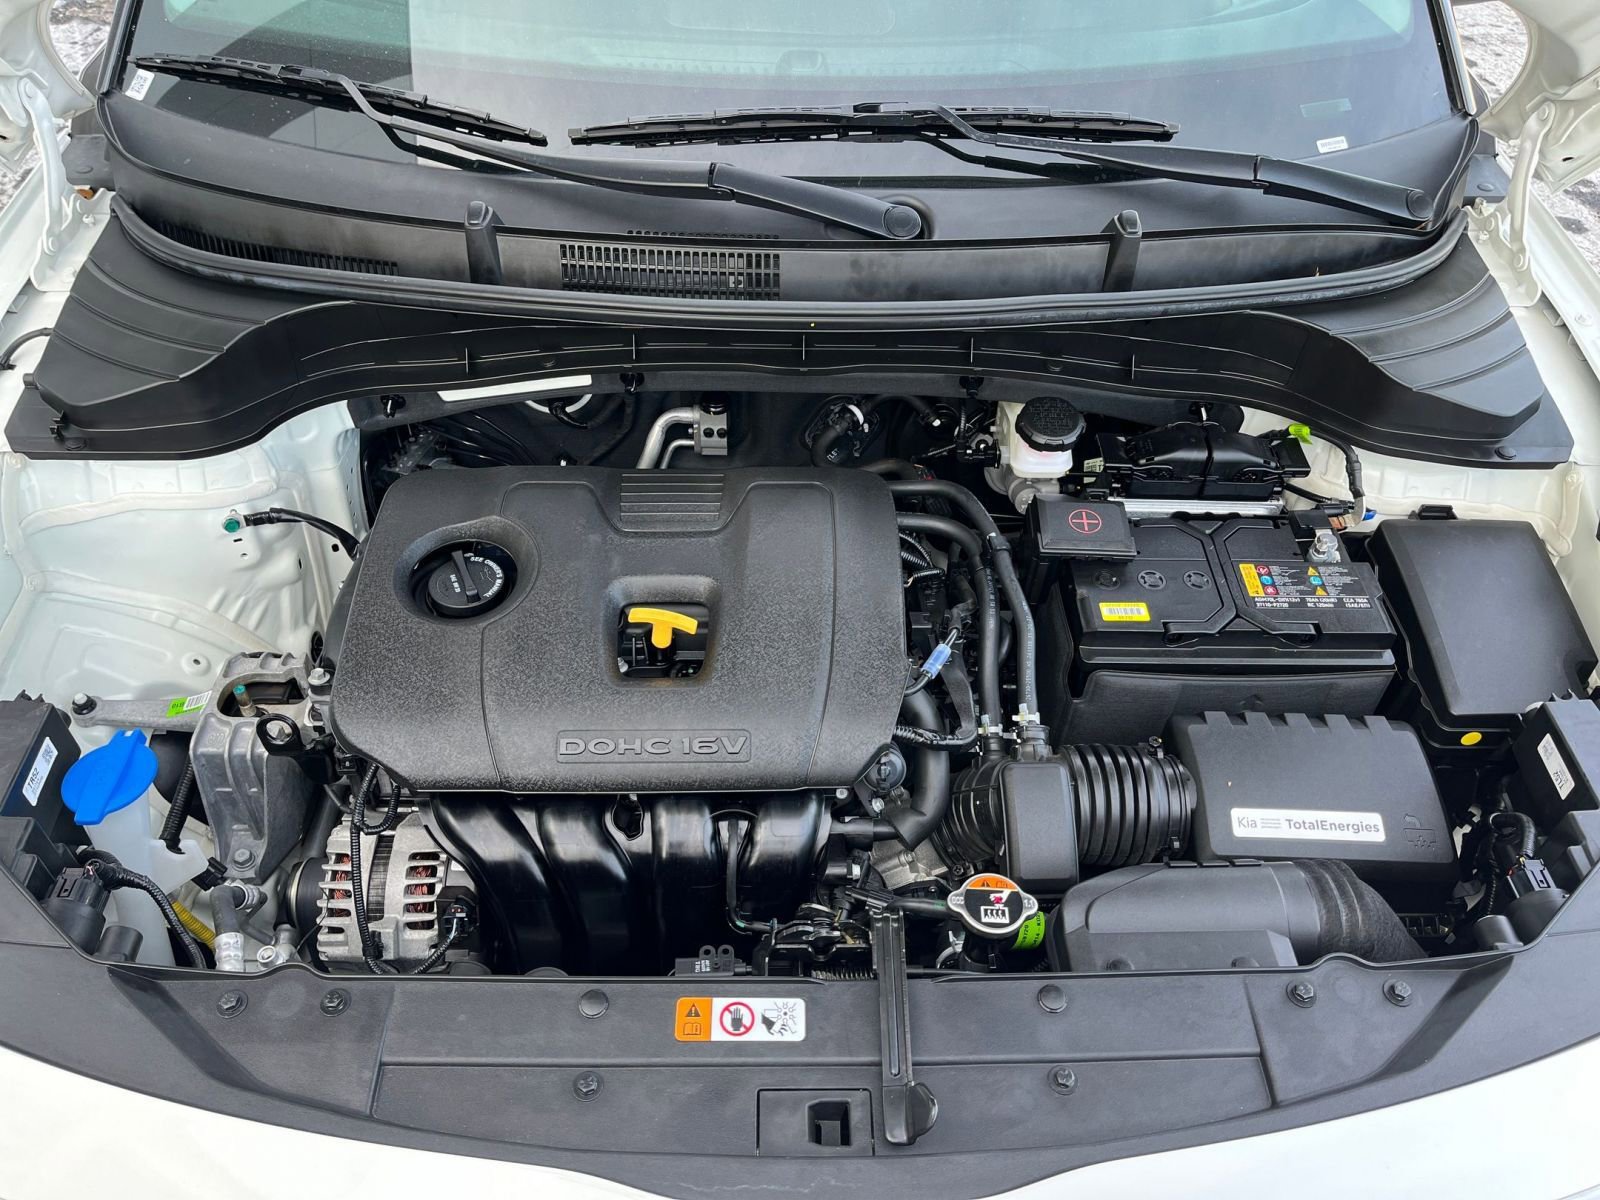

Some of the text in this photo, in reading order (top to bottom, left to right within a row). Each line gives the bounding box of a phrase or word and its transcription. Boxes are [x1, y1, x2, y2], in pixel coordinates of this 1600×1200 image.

[484, 559, 503, 577] OWNER'S
[482, 579, 503, 597] MANUAL
[559, 736, 748, 755] DOHC 16V
[1237, 816, 1380, 834] Kia TotalEnergies
